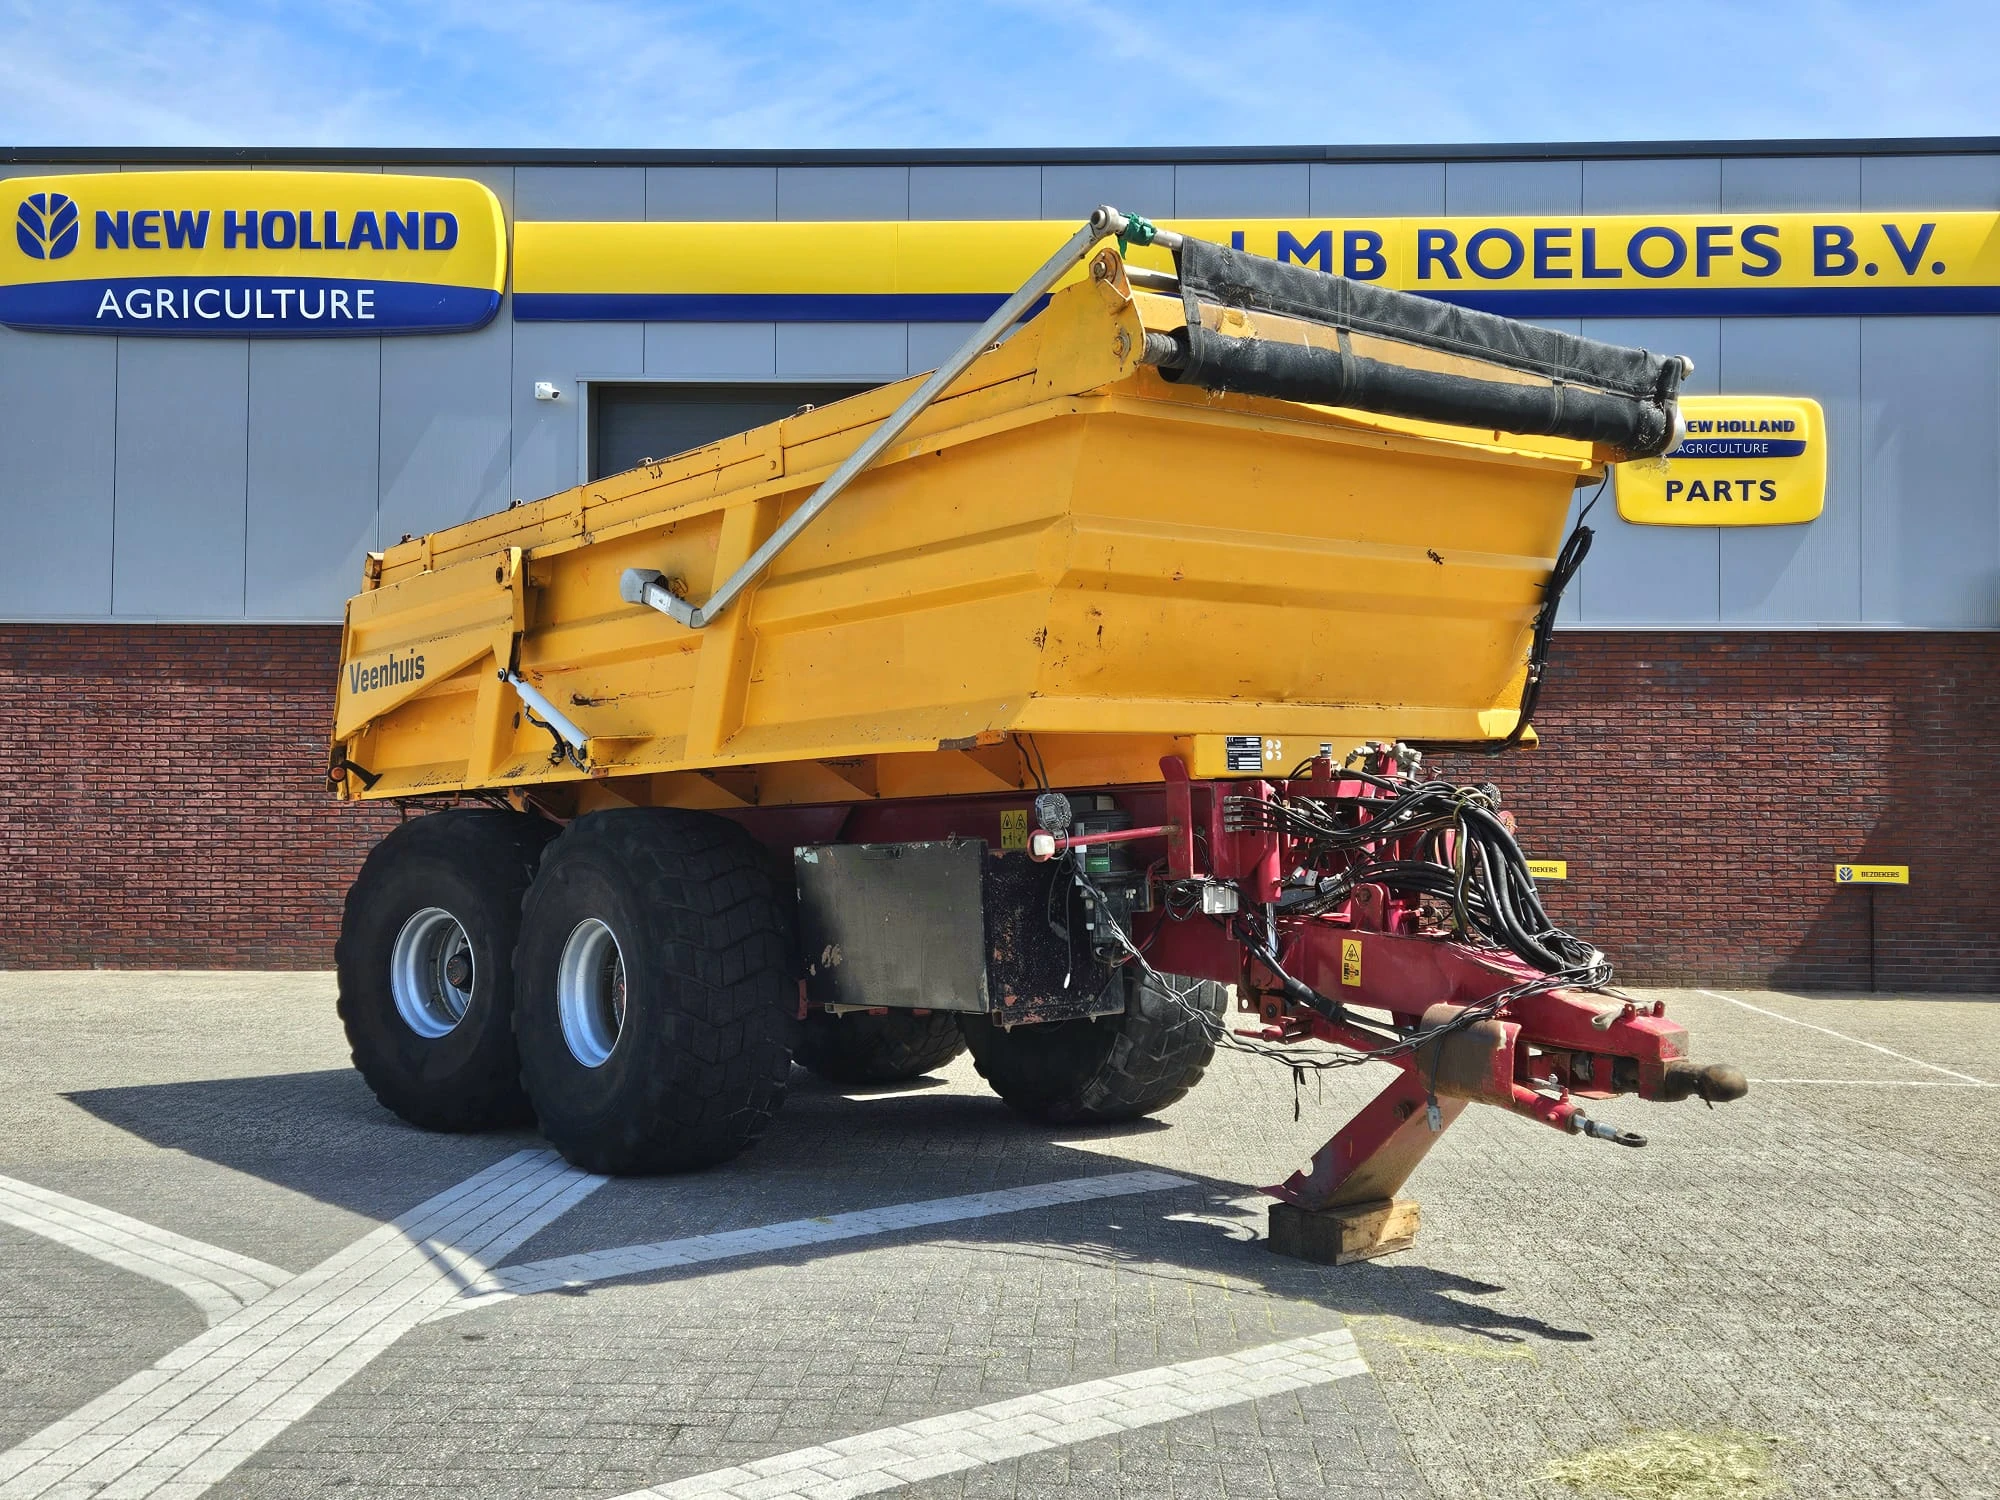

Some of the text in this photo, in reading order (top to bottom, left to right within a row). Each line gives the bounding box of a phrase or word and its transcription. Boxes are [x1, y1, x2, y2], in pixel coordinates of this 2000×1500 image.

[96, 211, 459, 250] NEW HOLLAND
[1418, 225, 1781, 279] ROELOFS
[1813, 224, 1946, 276] B.V.
[97, 289, 375, 319] AGRICULTURE
[1685, 420, 1796, 433] EW HOLLAND
[1676, 443, 1769, 454] AGRICULTURE
[1666, 479, 1777, 502] PARTS
[349, 648, 425, 695] Veenhuis
